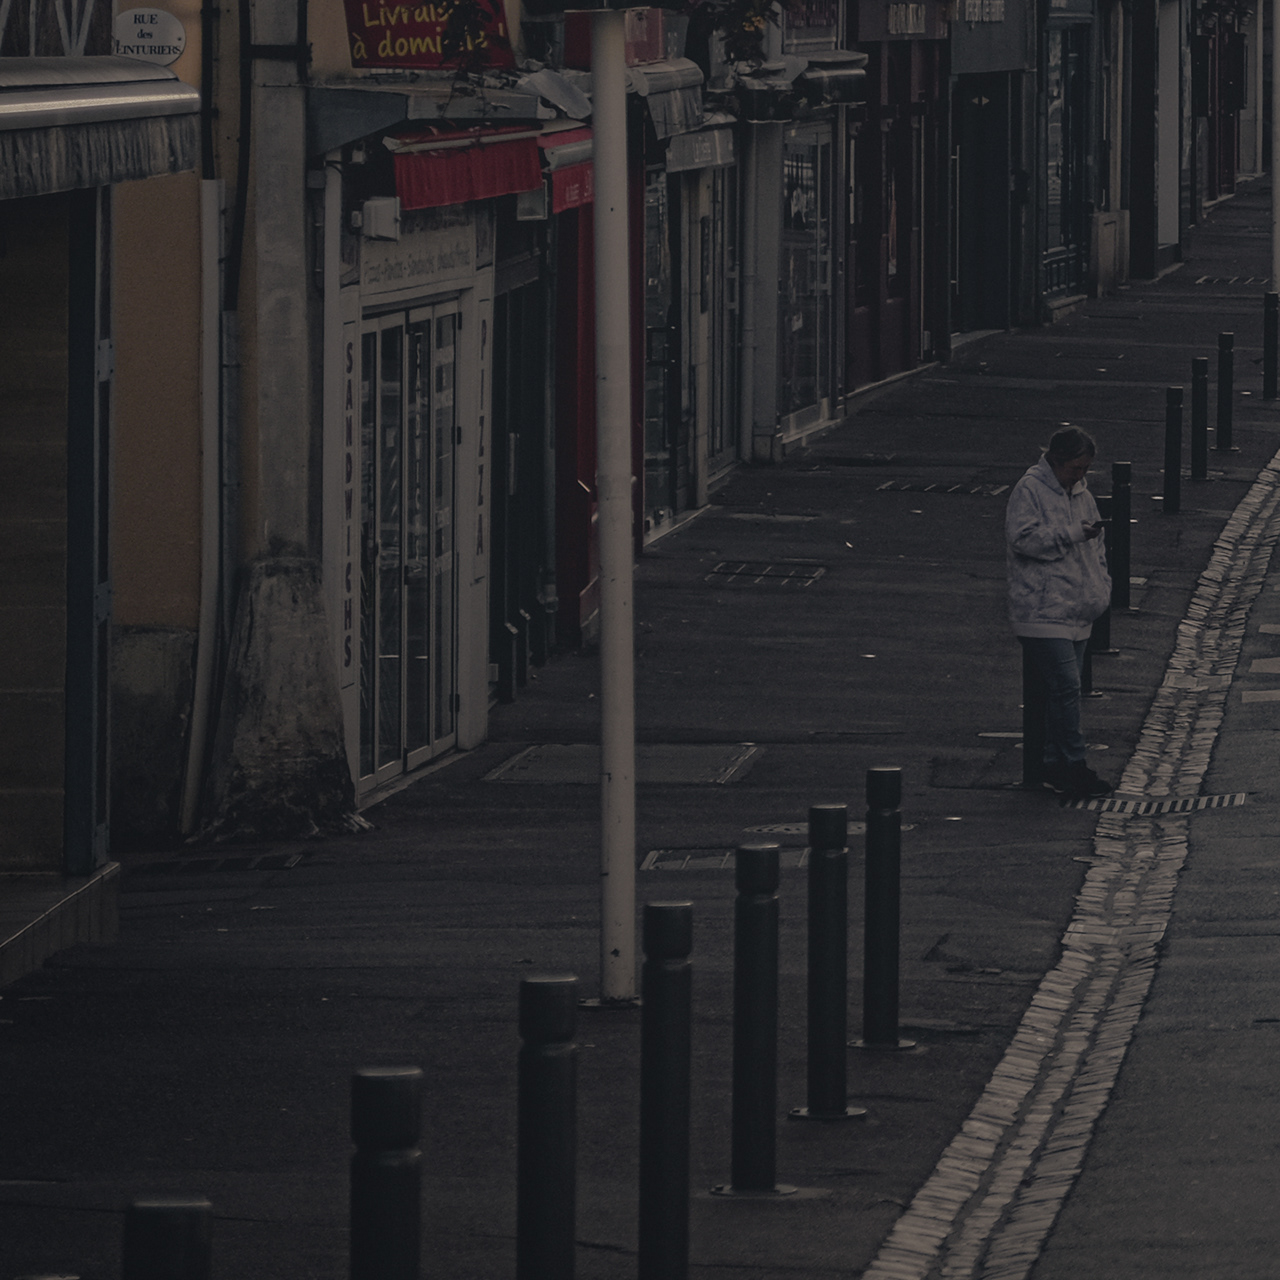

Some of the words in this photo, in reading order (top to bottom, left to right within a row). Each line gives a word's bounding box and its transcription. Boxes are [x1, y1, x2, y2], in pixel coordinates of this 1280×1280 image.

[133, 13, 159, 25] RUE
[137, 28, 153, 39] des
[351, 31, 369, 60] à
[476, 318, 488, 558] PIZZA
[344, 340, 354, 669] SANDWICHS
